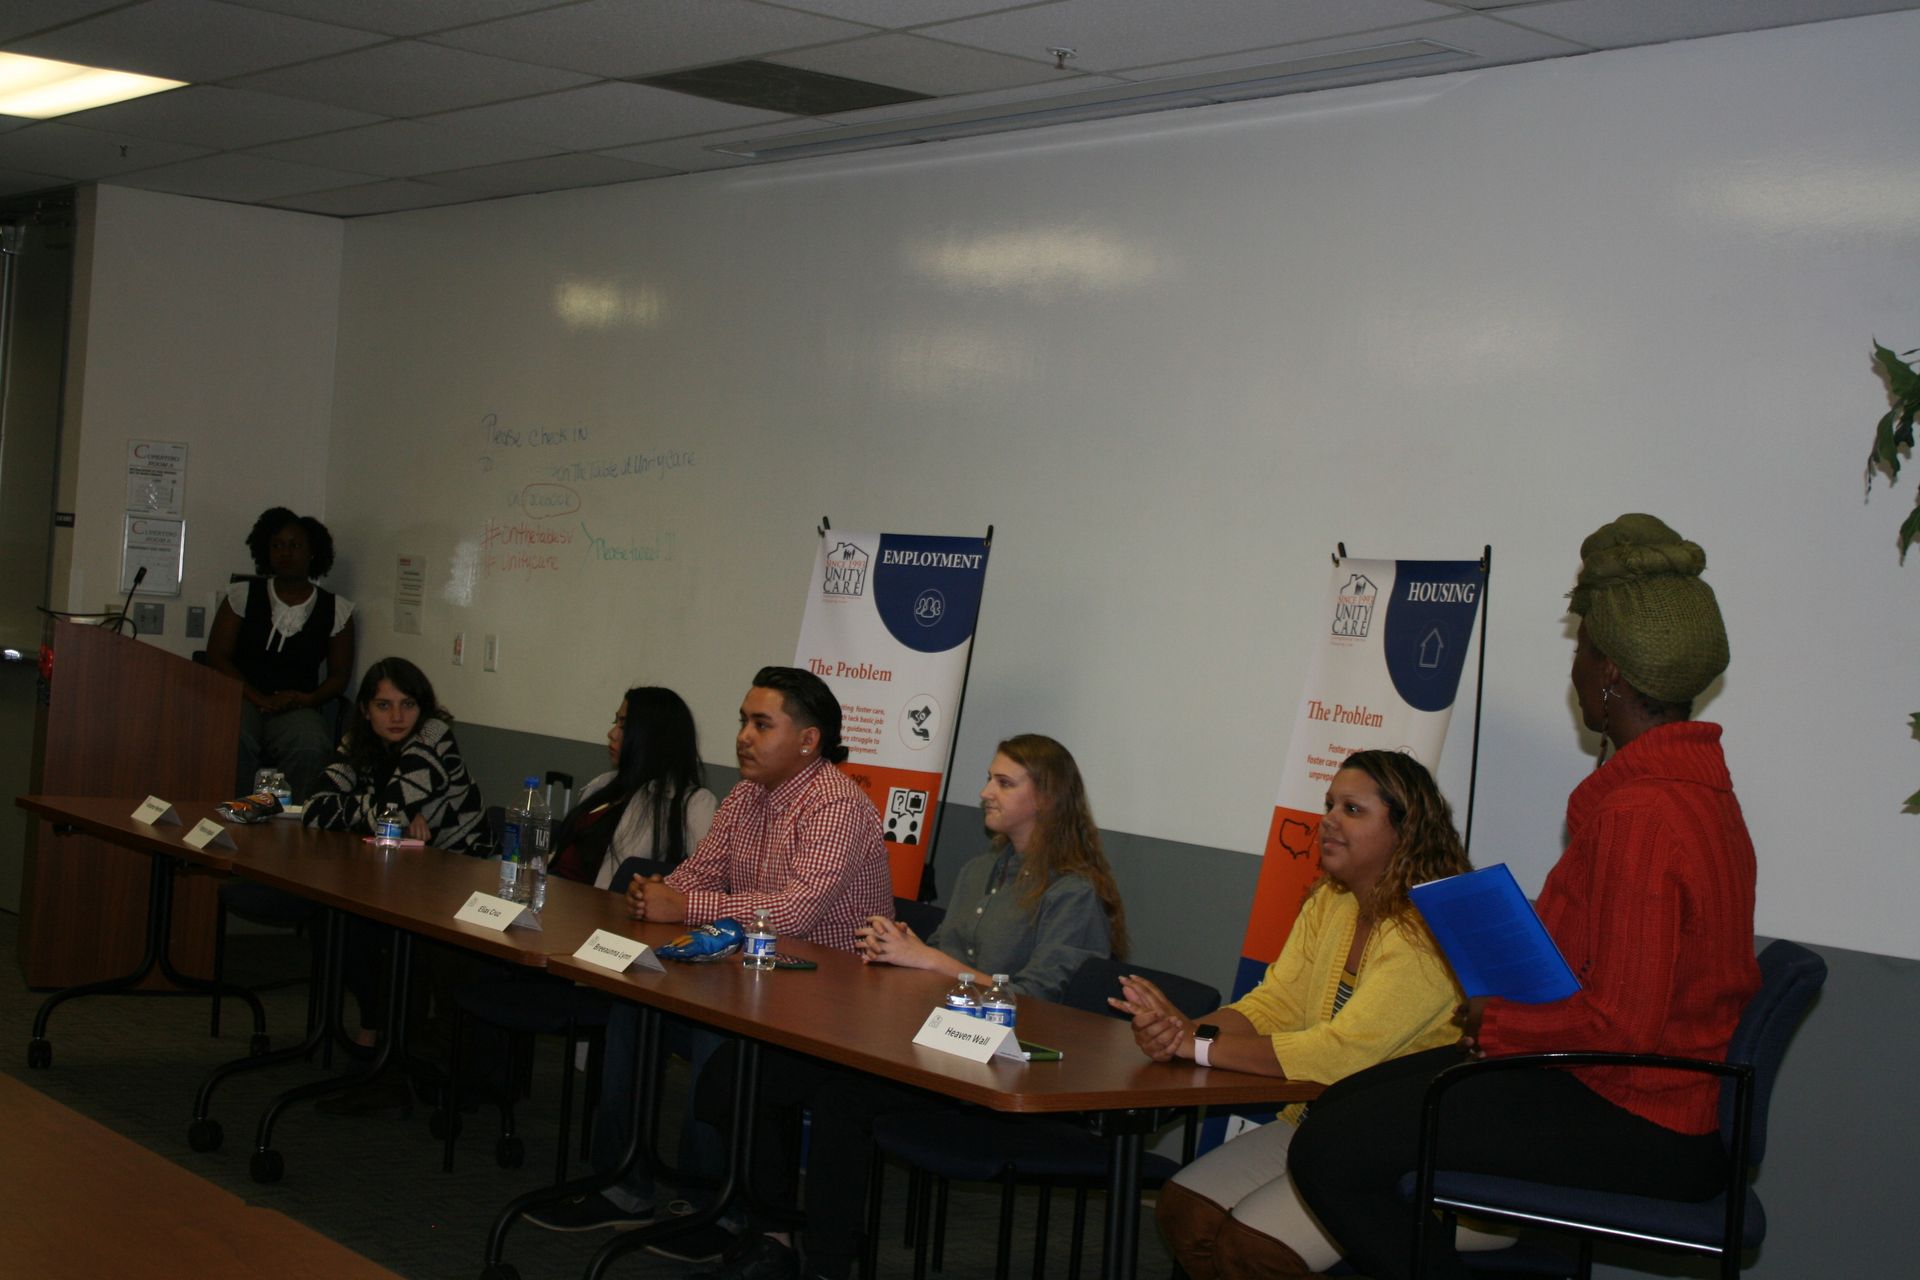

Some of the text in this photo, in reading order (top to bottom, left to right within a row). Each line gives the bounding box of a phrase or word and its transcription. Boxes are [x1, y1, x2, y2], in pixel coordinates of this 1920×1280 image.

[883, 549, 983, 570] EMPLOYMENT
[825, 567, 864, 583] UNITY
[823, 580, 860, 594] CARE
[1408, 582, 1475, 603] HOUSING
[1336, 603, 1372, 622] UNITY
[1332, 619, 1367, 635] CARE
[808, 658, 892, 681] The Problem
[1308, 700, 1383, 728] The Problem
[945, 1027, 991, 1046] Heaven Wall
